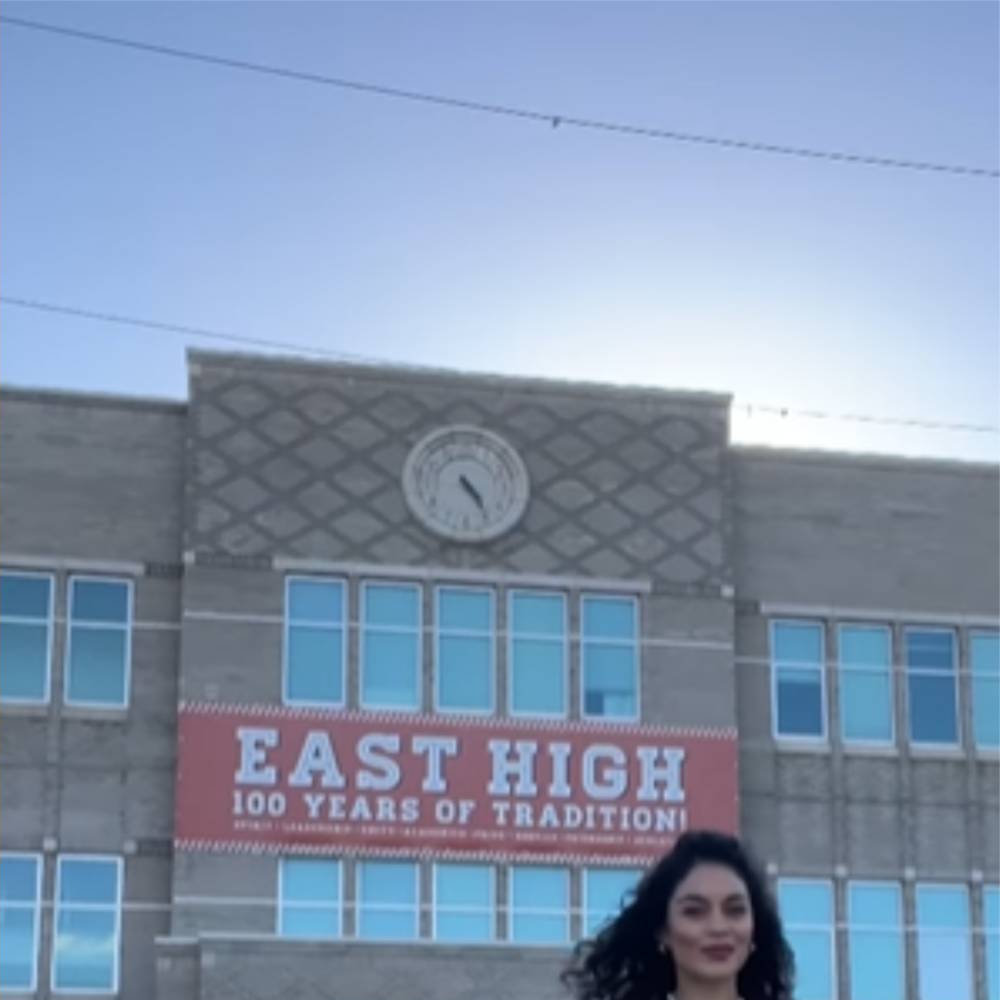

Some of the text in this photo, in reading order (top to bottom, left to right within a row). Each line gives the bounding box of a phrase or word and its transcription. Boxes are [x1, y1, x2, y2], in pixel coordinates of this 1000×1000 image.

[234, 725, 686, 802] EAST HIGH
[232, 790, 287, 817] 100
[303, 793, 420, 824] YEARS
[435, 798, 475, 826] OF
[492, 801, 687, 833] TRADITION!
